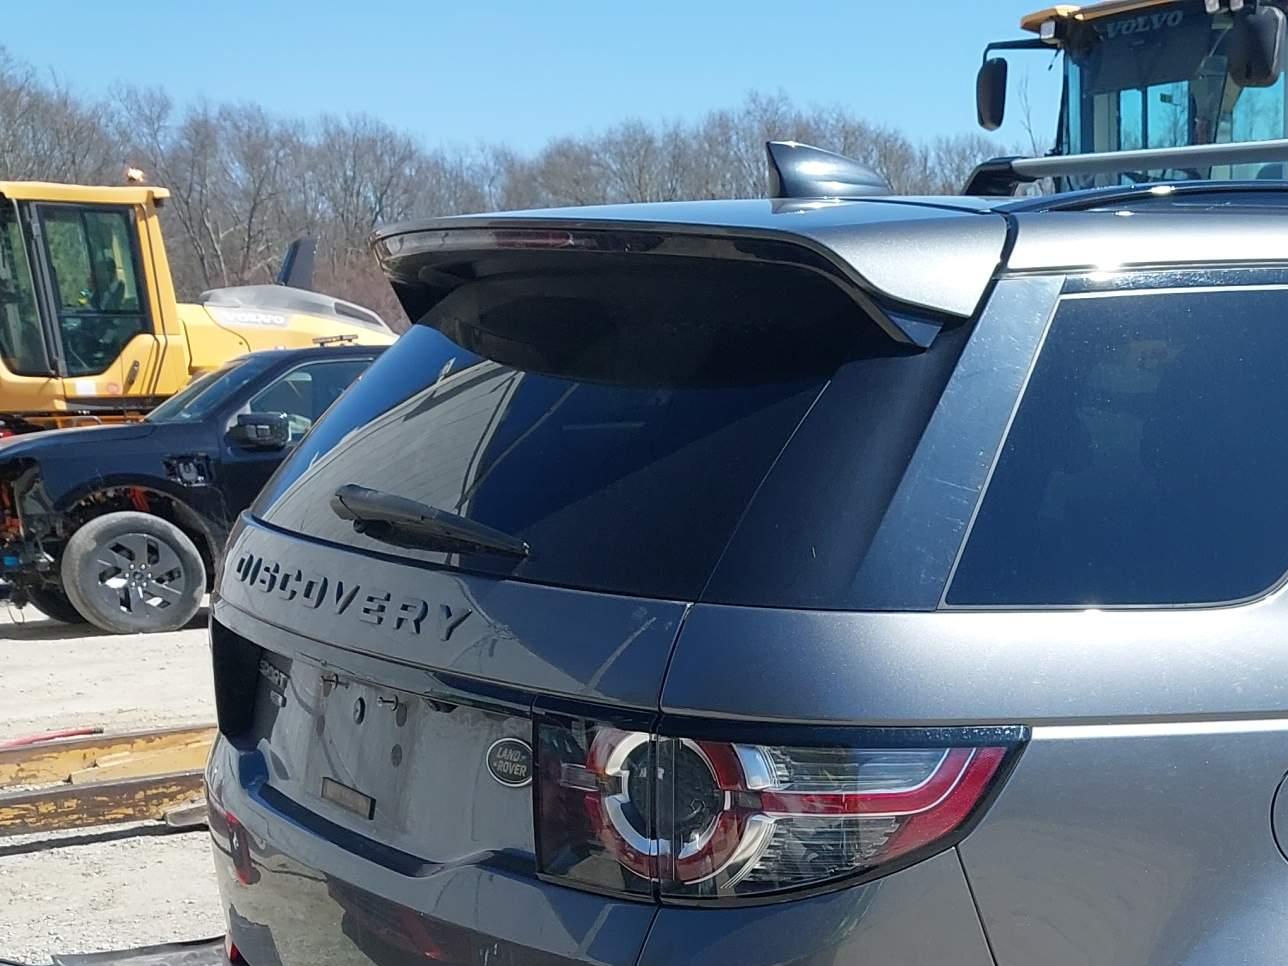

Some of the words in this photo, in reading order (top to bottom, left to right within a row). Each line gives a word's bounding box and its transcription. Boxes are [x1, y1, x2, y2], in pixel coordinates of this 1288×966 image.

[1106, 9, 1184, 39] VOLVO
[235, 552, 473, 642] DISCOVERY
[496, 746, 521, 762] LAND
[497, 759, 527, 777] ROVER
